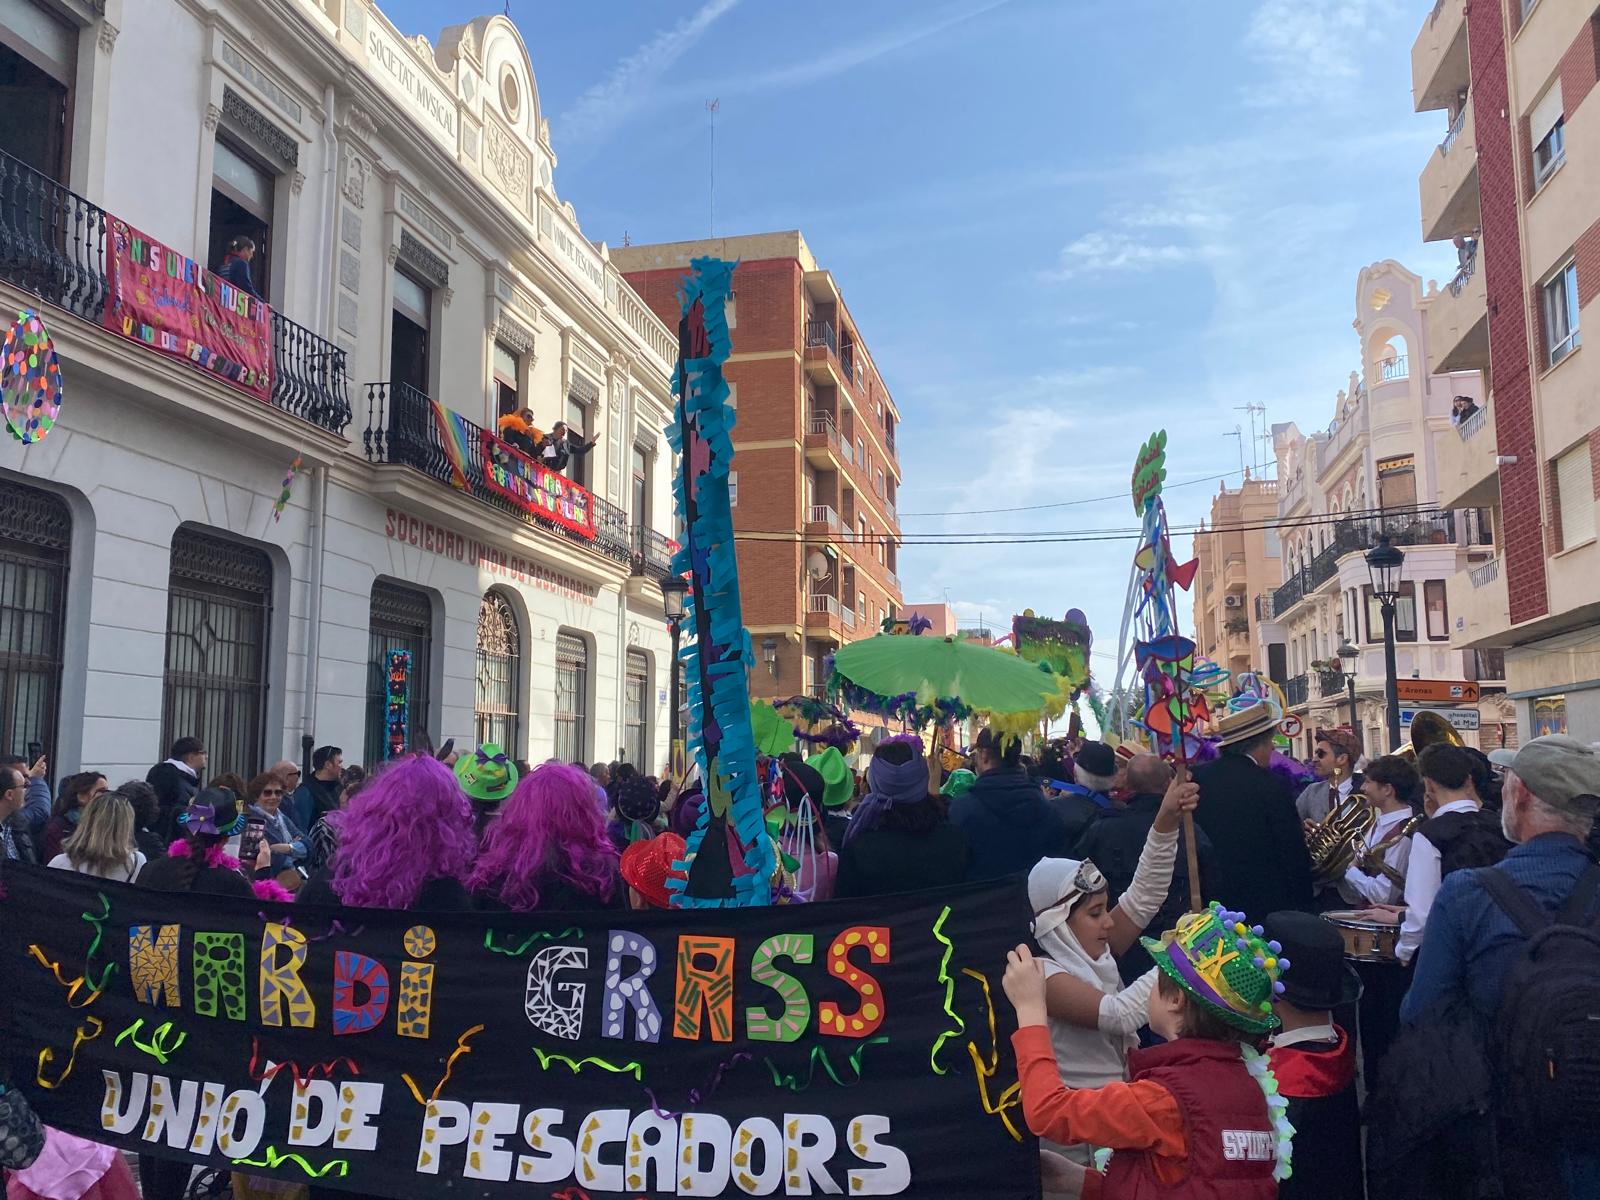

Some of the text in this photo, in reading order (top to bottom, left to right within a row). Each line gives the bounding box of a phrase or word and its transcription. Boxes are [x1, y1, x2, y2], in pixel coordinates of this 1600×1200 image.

[369, 30, 415, 94] SOCIETAT
[130, 237, 160, 272] NOS
[166, 250, 194, 284] UNE
[161, 330, 178, 352] DE
[185, 338, 256, 386] PESCADORS
[385, 507, 594, 606] SOCIEDAD UNION DE PESCADORES
[1405, 686, 1432, 694] Arenas
[525, 926, 890, 1043] GRASS
[101, 1060, 911, 1197] UNIÓ DE PESCADORS
[1222, 1129, 1277, 1161] SPIDE
